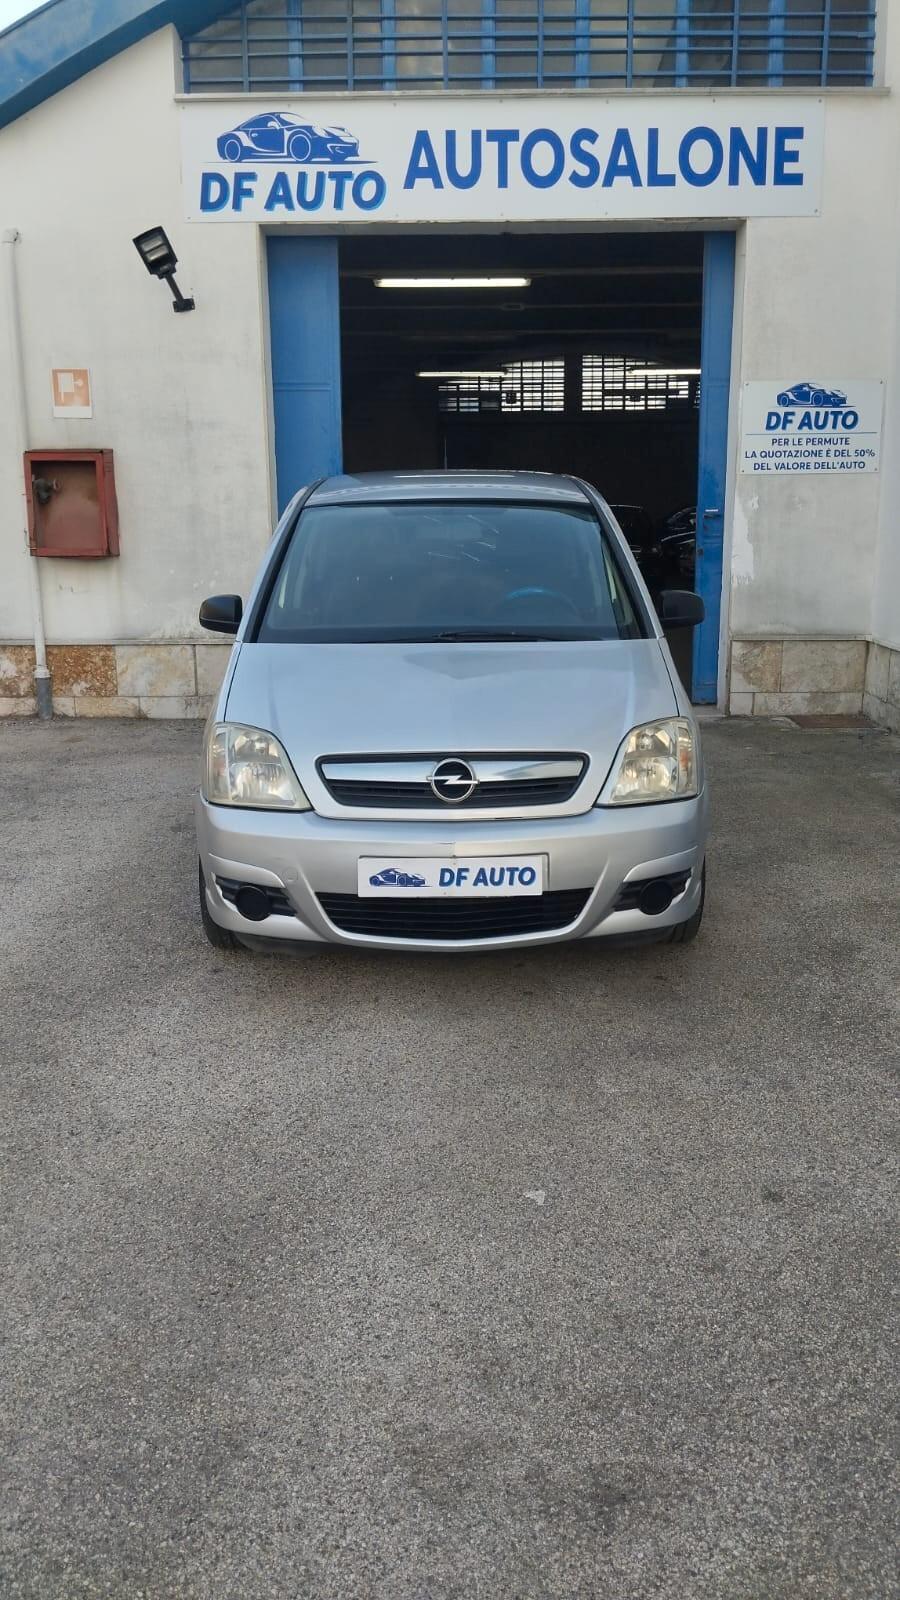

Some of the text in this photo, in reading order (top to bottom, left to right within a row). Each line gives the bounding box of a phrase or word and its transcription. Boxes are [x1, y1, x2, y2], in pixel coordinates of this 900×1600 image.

[404, 126, 804, 190] AUTOSALONE
[199, 169, 387, 213] DF AUTO
[765, 410, 859, 431] DF AUTO
[771, 437, 850, 446] PER LE PERMUTE
[745, 450, 757, 459] LA
[760, 449, 823, 458] QUOTAZIONE
[834, 449, 852, 457] DEL
[854, 449, 875, 457] 50%
[753, 461, 866, 471] DEL VALORE DELL'AUTO
[438, 866, 537, 887] DF AUTO
